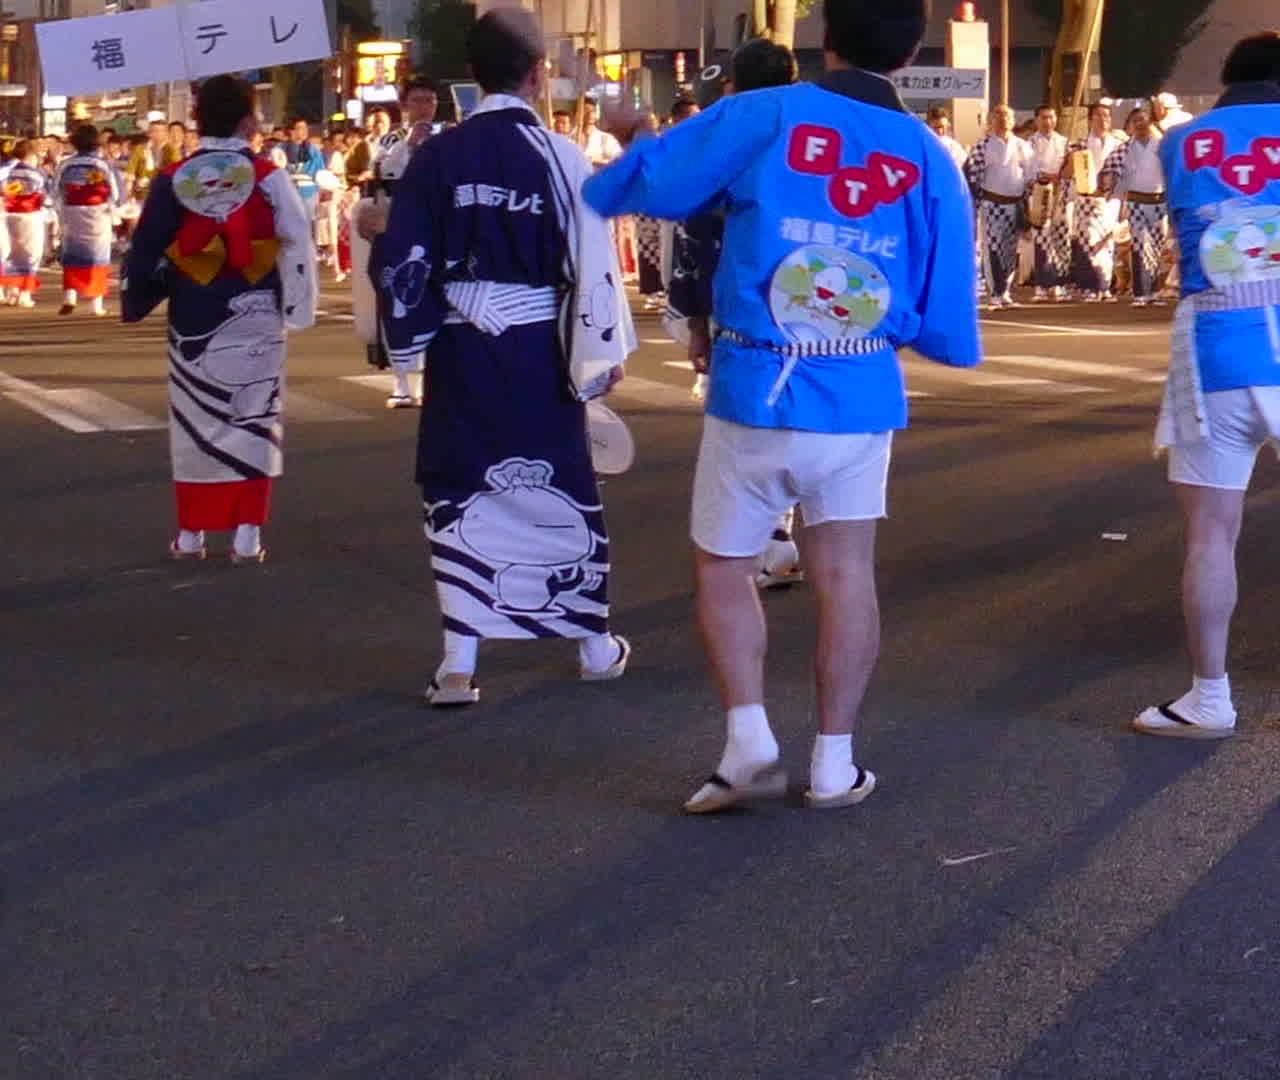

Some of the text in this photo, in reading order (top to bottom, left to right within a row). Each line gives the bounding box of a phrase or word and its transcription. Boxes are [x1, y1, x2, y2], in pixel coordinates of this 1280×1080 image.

[91, 16, 299, 71] 福テレ
[780, 218, 897, 260] 福島テレビ
